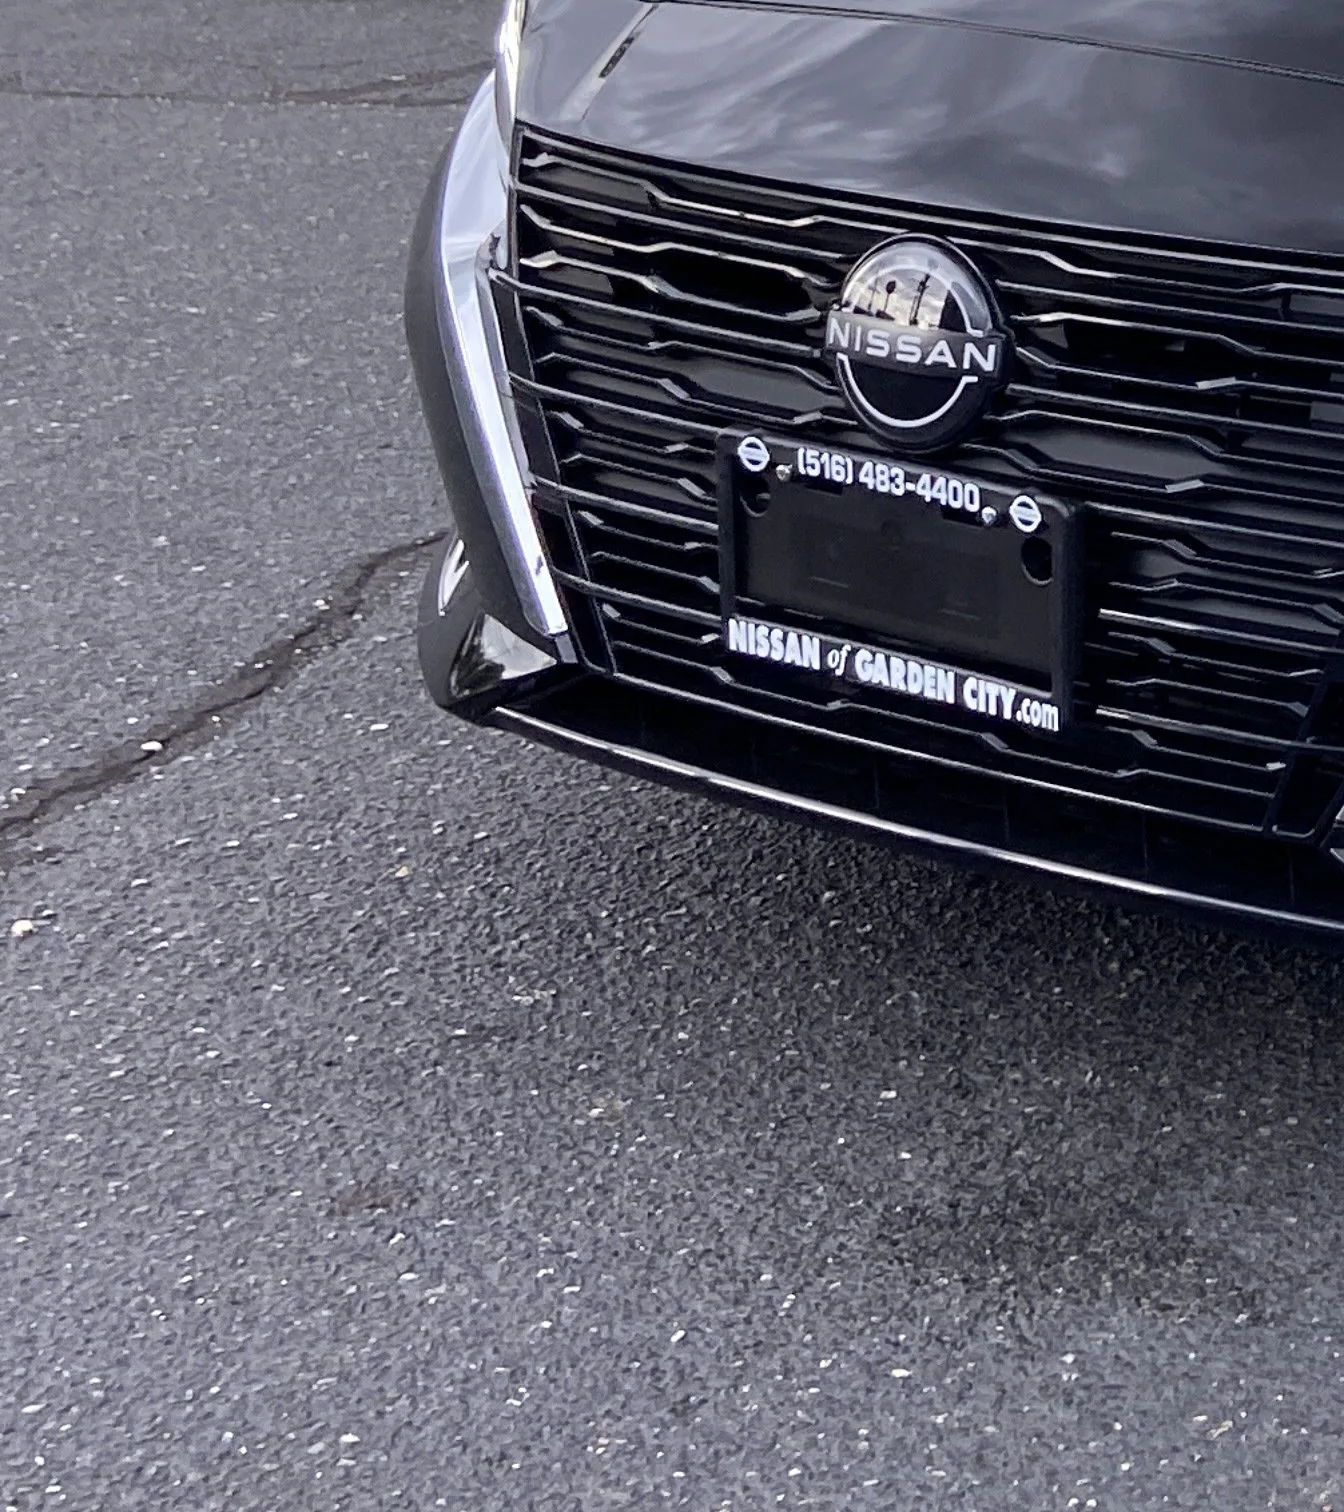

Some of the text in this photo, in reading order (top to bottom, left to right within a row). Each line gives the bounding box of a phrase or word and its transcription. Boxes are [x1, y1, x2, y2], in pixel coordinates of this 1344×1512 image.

[828, 317, 996, 372] NISSAN
[798, 446, 981, 513] (516) 483-4400
[728, 618, 820, 671] NISSAN
[827, 644, 852, 677] of
[854, 648, 956, 704] GARDEN
